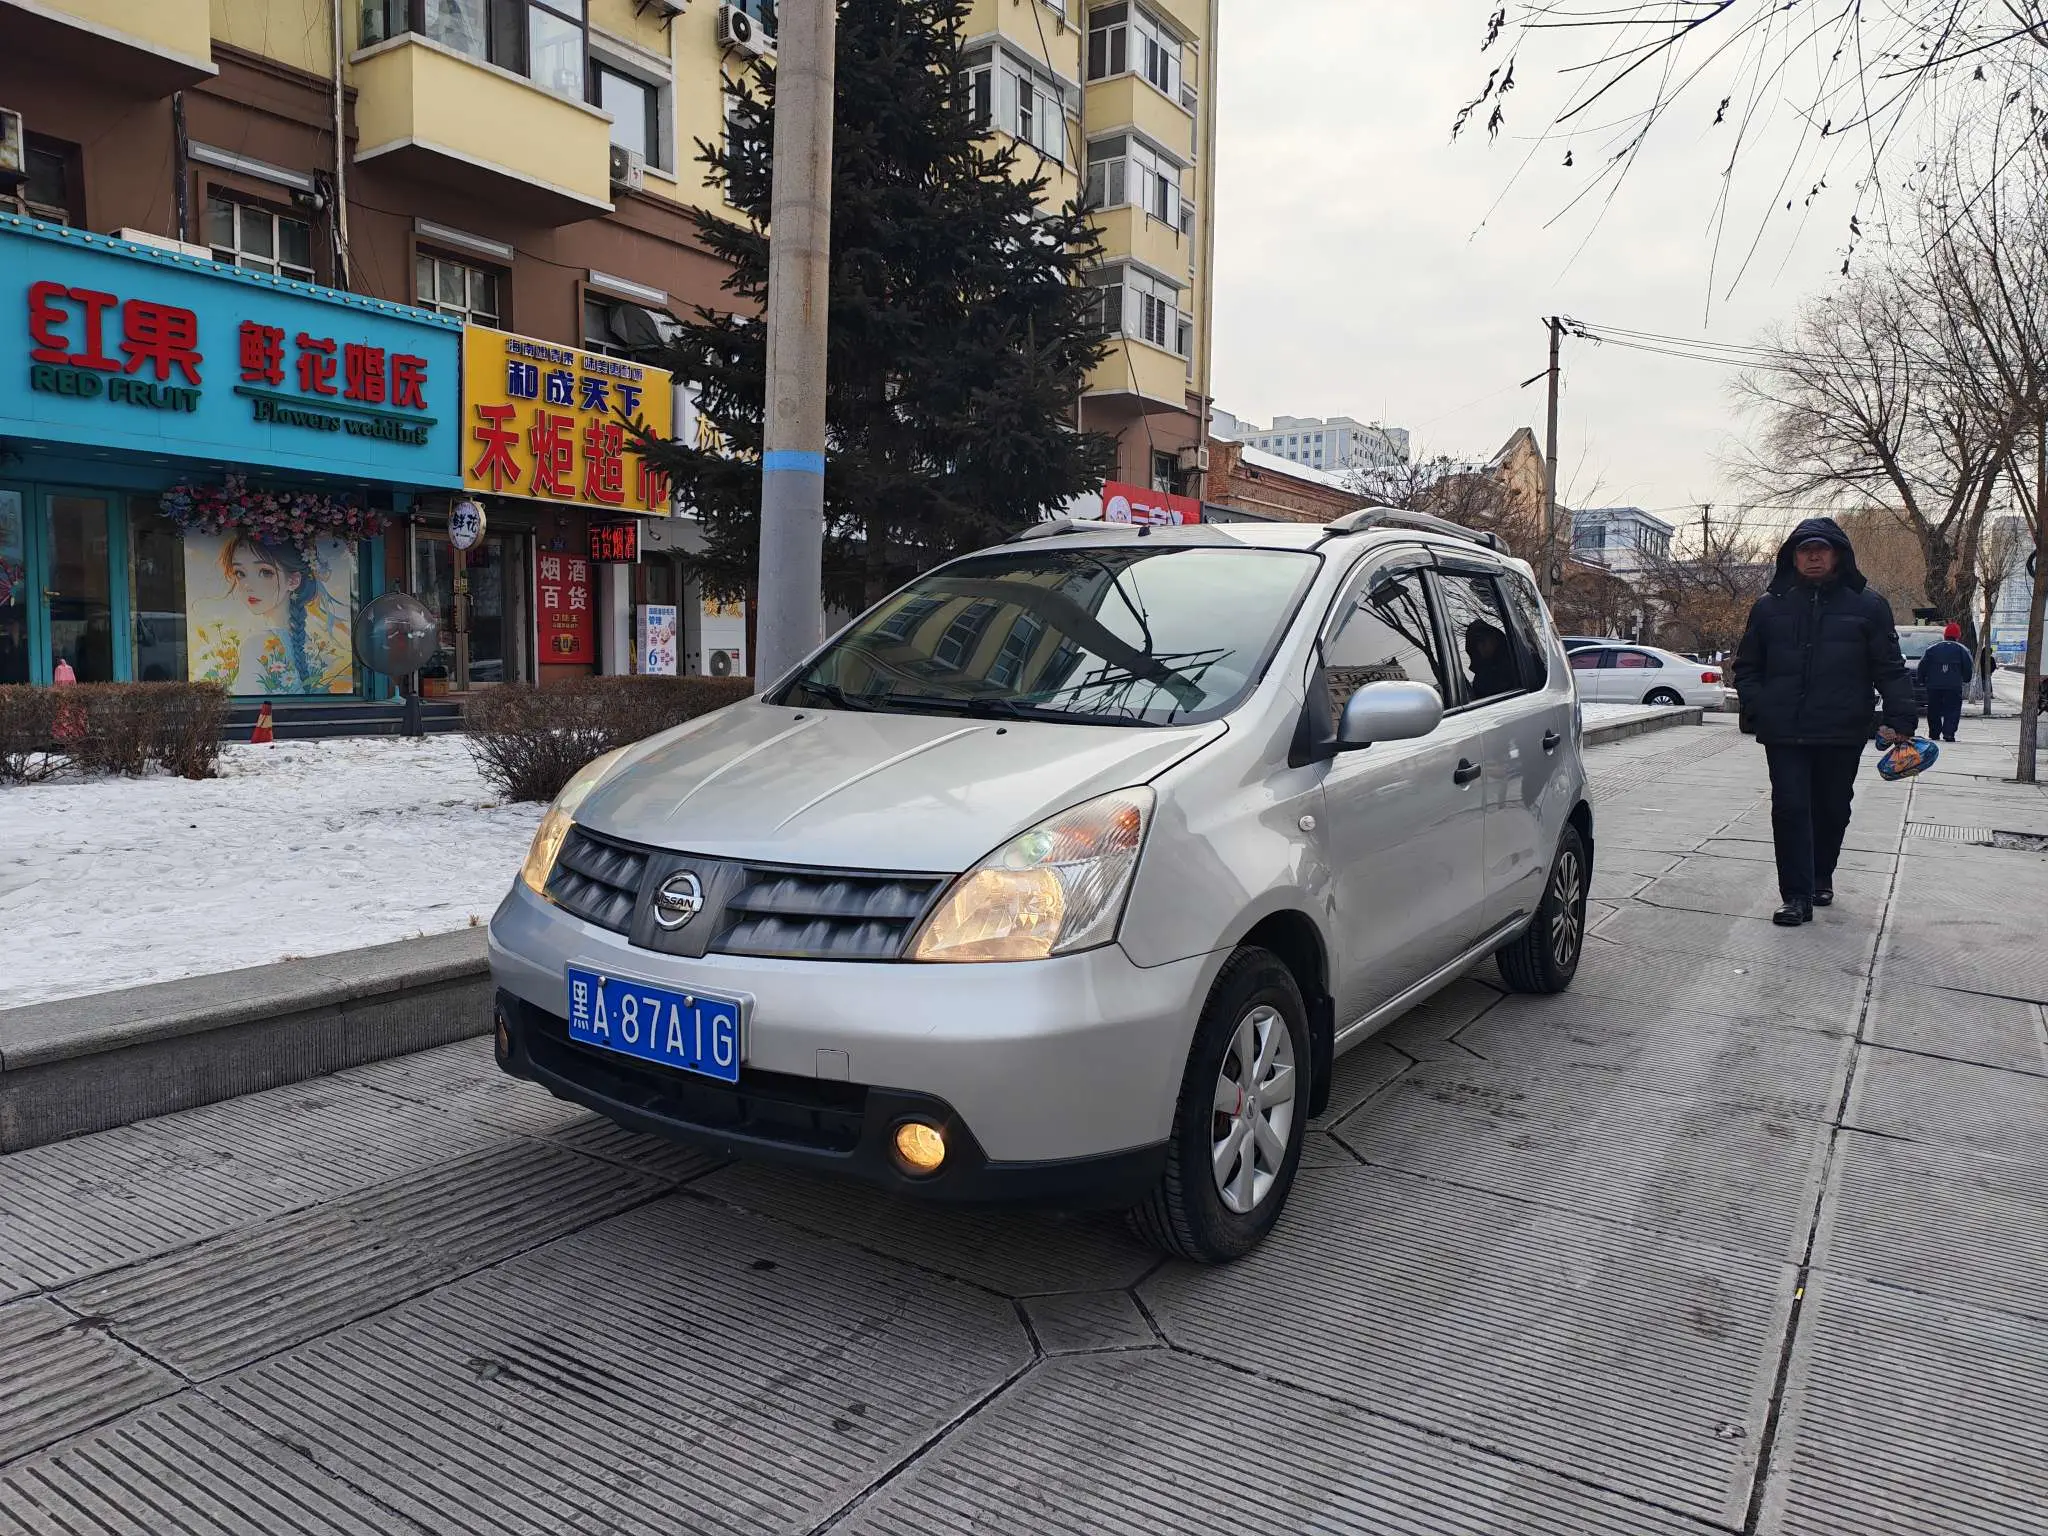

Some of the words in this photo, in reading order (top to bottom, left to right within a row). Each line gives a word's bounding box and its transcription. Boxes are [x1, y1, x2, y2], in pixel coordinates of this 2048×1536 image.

[28, 280, 204, 385] 红果
[31, 364, 103, 399] RED
[108, 377, 203, 413] FRUIT
[238, 319, 429, 410] 鲜花婚庆
[507, 359, 644, 417] 和成天下
[252, 398, 342, 432] Flowers
[344, 417, 429, 447] wedding
[452, 511, 478, 534] 鲜花
[587, 524, 636, 561] 百货烟酒
[540, 555, 588, 583] 烟酒
[540, 584, 588, 611] 百货
